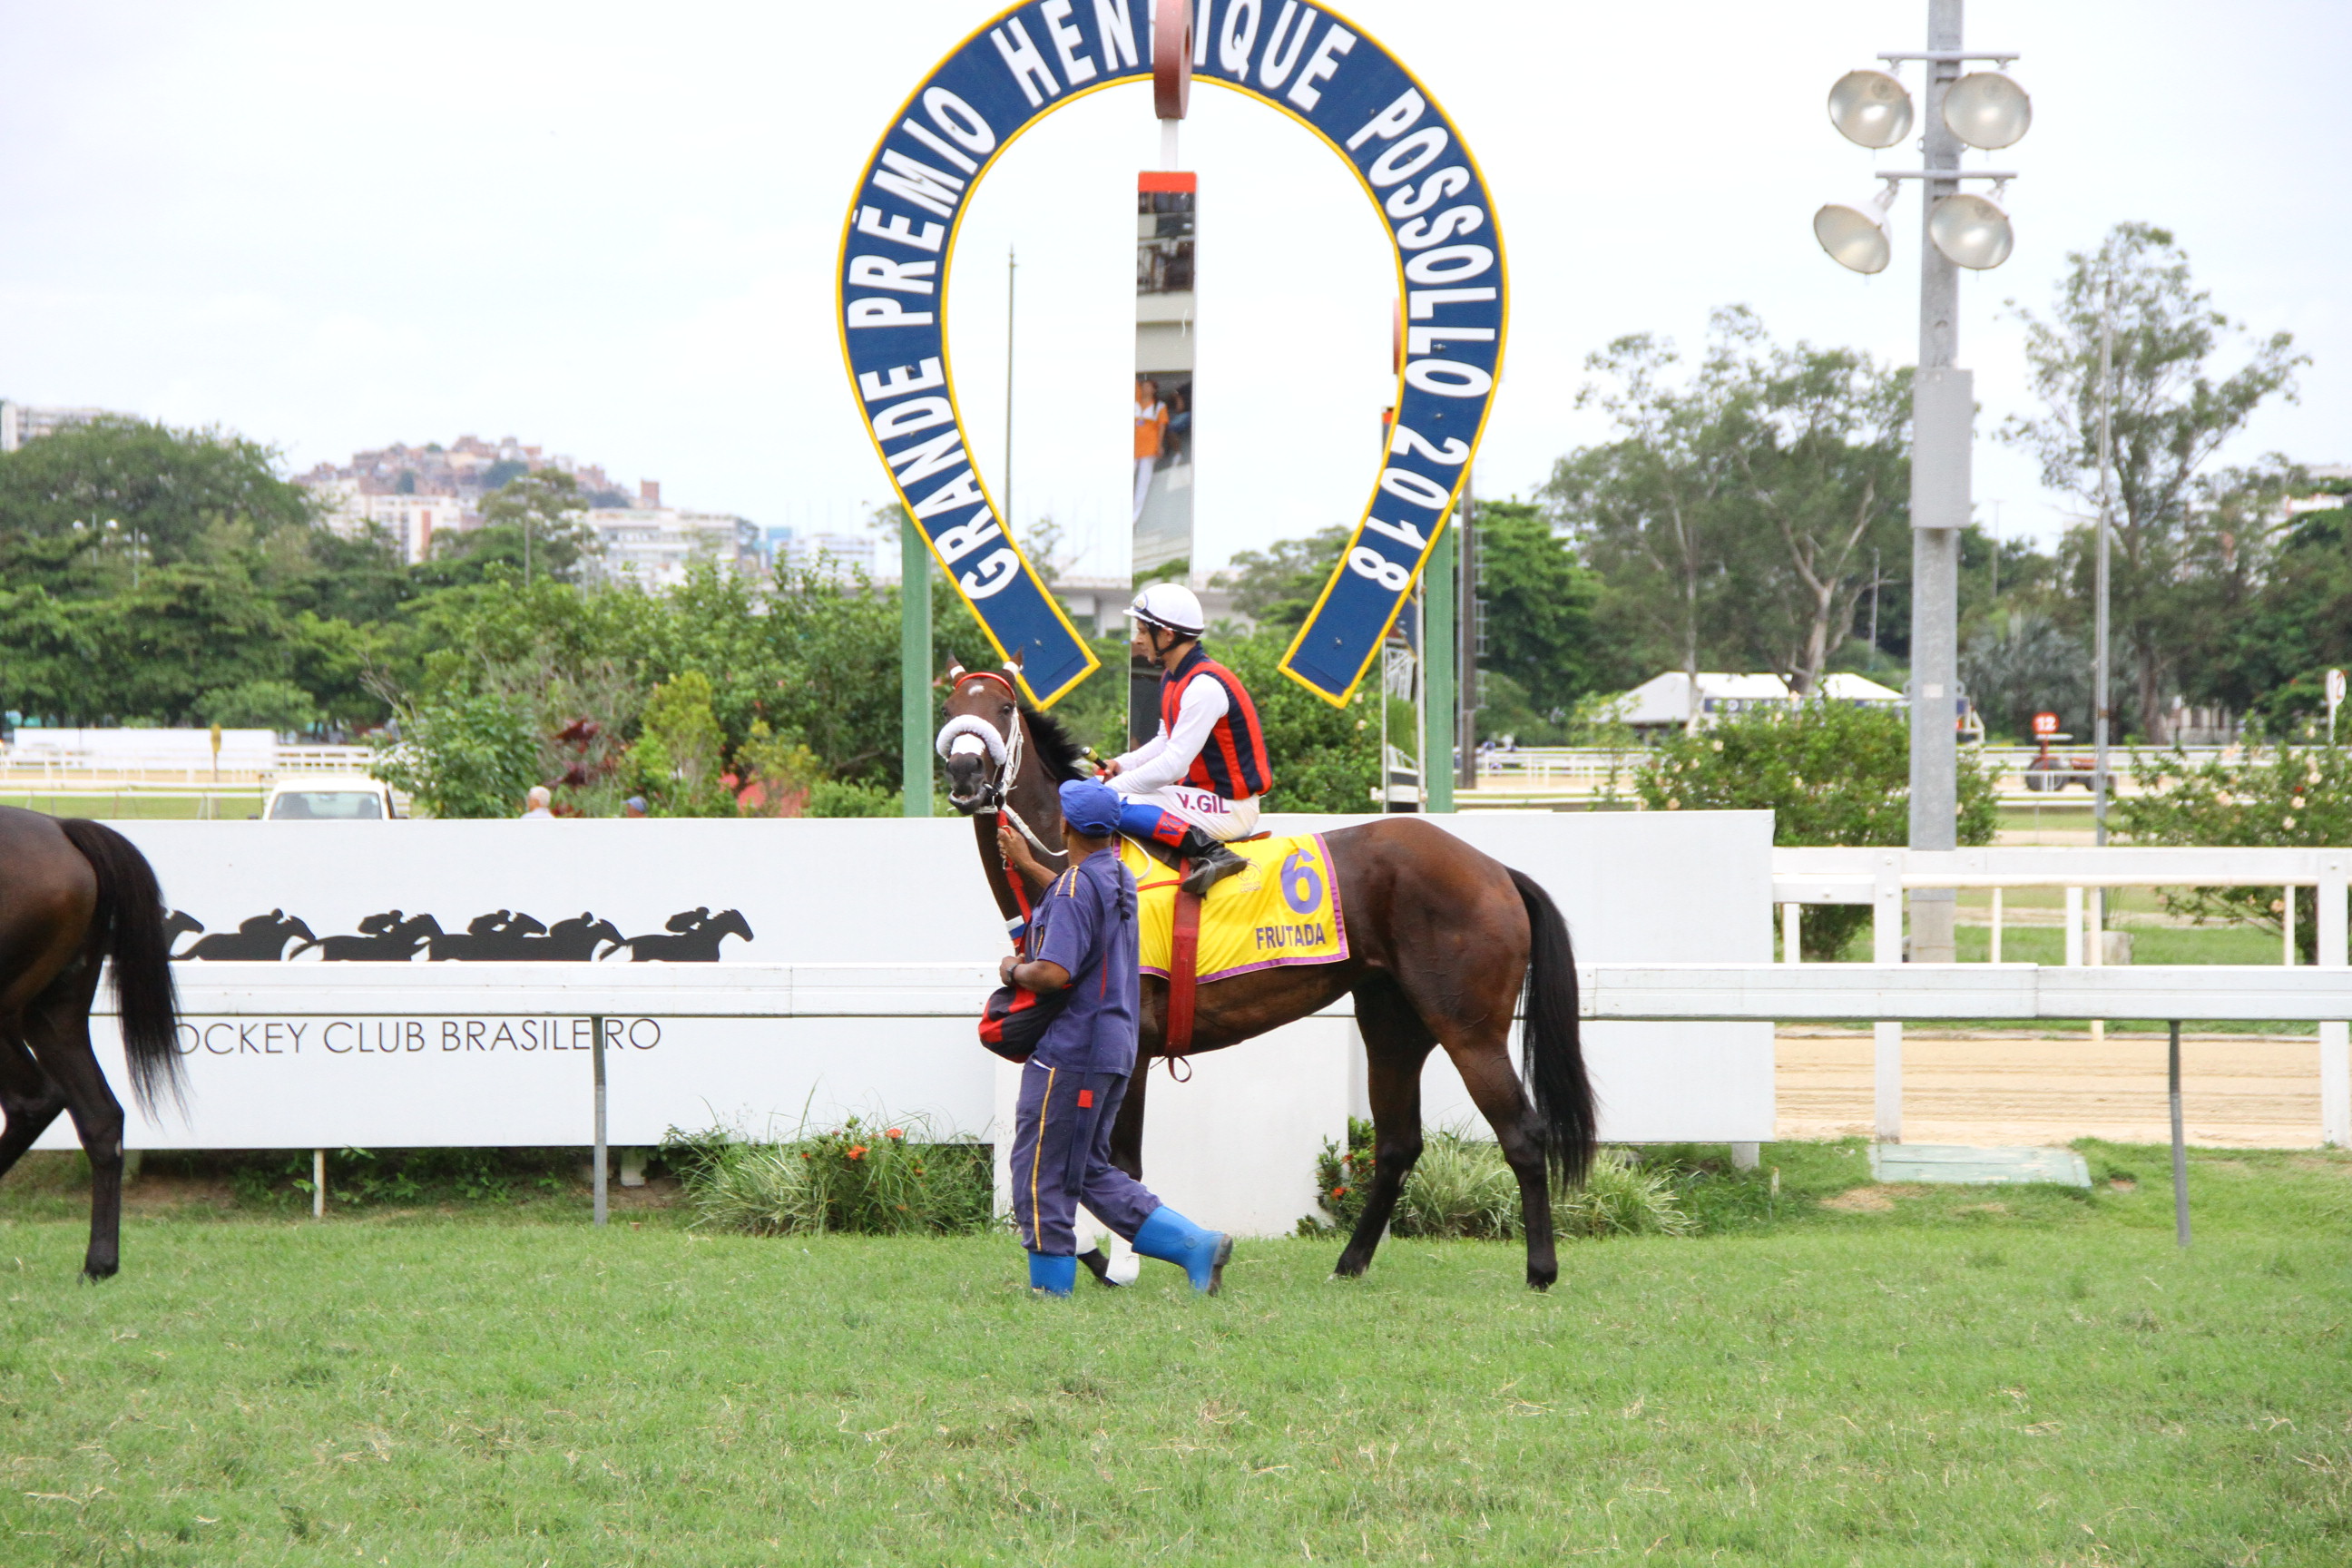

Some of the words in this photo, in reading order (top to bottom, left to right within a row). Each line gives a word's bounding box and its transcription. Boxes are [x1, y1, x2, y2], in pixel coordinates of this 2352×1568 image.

[990, 0, 1357, 112] HENIQUE
[1346, 88, 1497, 398] POSSOLLO
[858, 357, 1020, 600] GRANDE
[1348, 423, 1470, 592] 2018
[2034, 716, 2056, 731] 12
[1176, 792, 1231, 814] V.GIL
[1280, 848, 1323, 915] 6
[1255, 922, 1327, 950] FRUTADA
[174, 1023, 308, 1054] OCKEY
[323, 1022, 425, 1053] CLUB
[442, 1018, 662, 1053] BRASILERO
